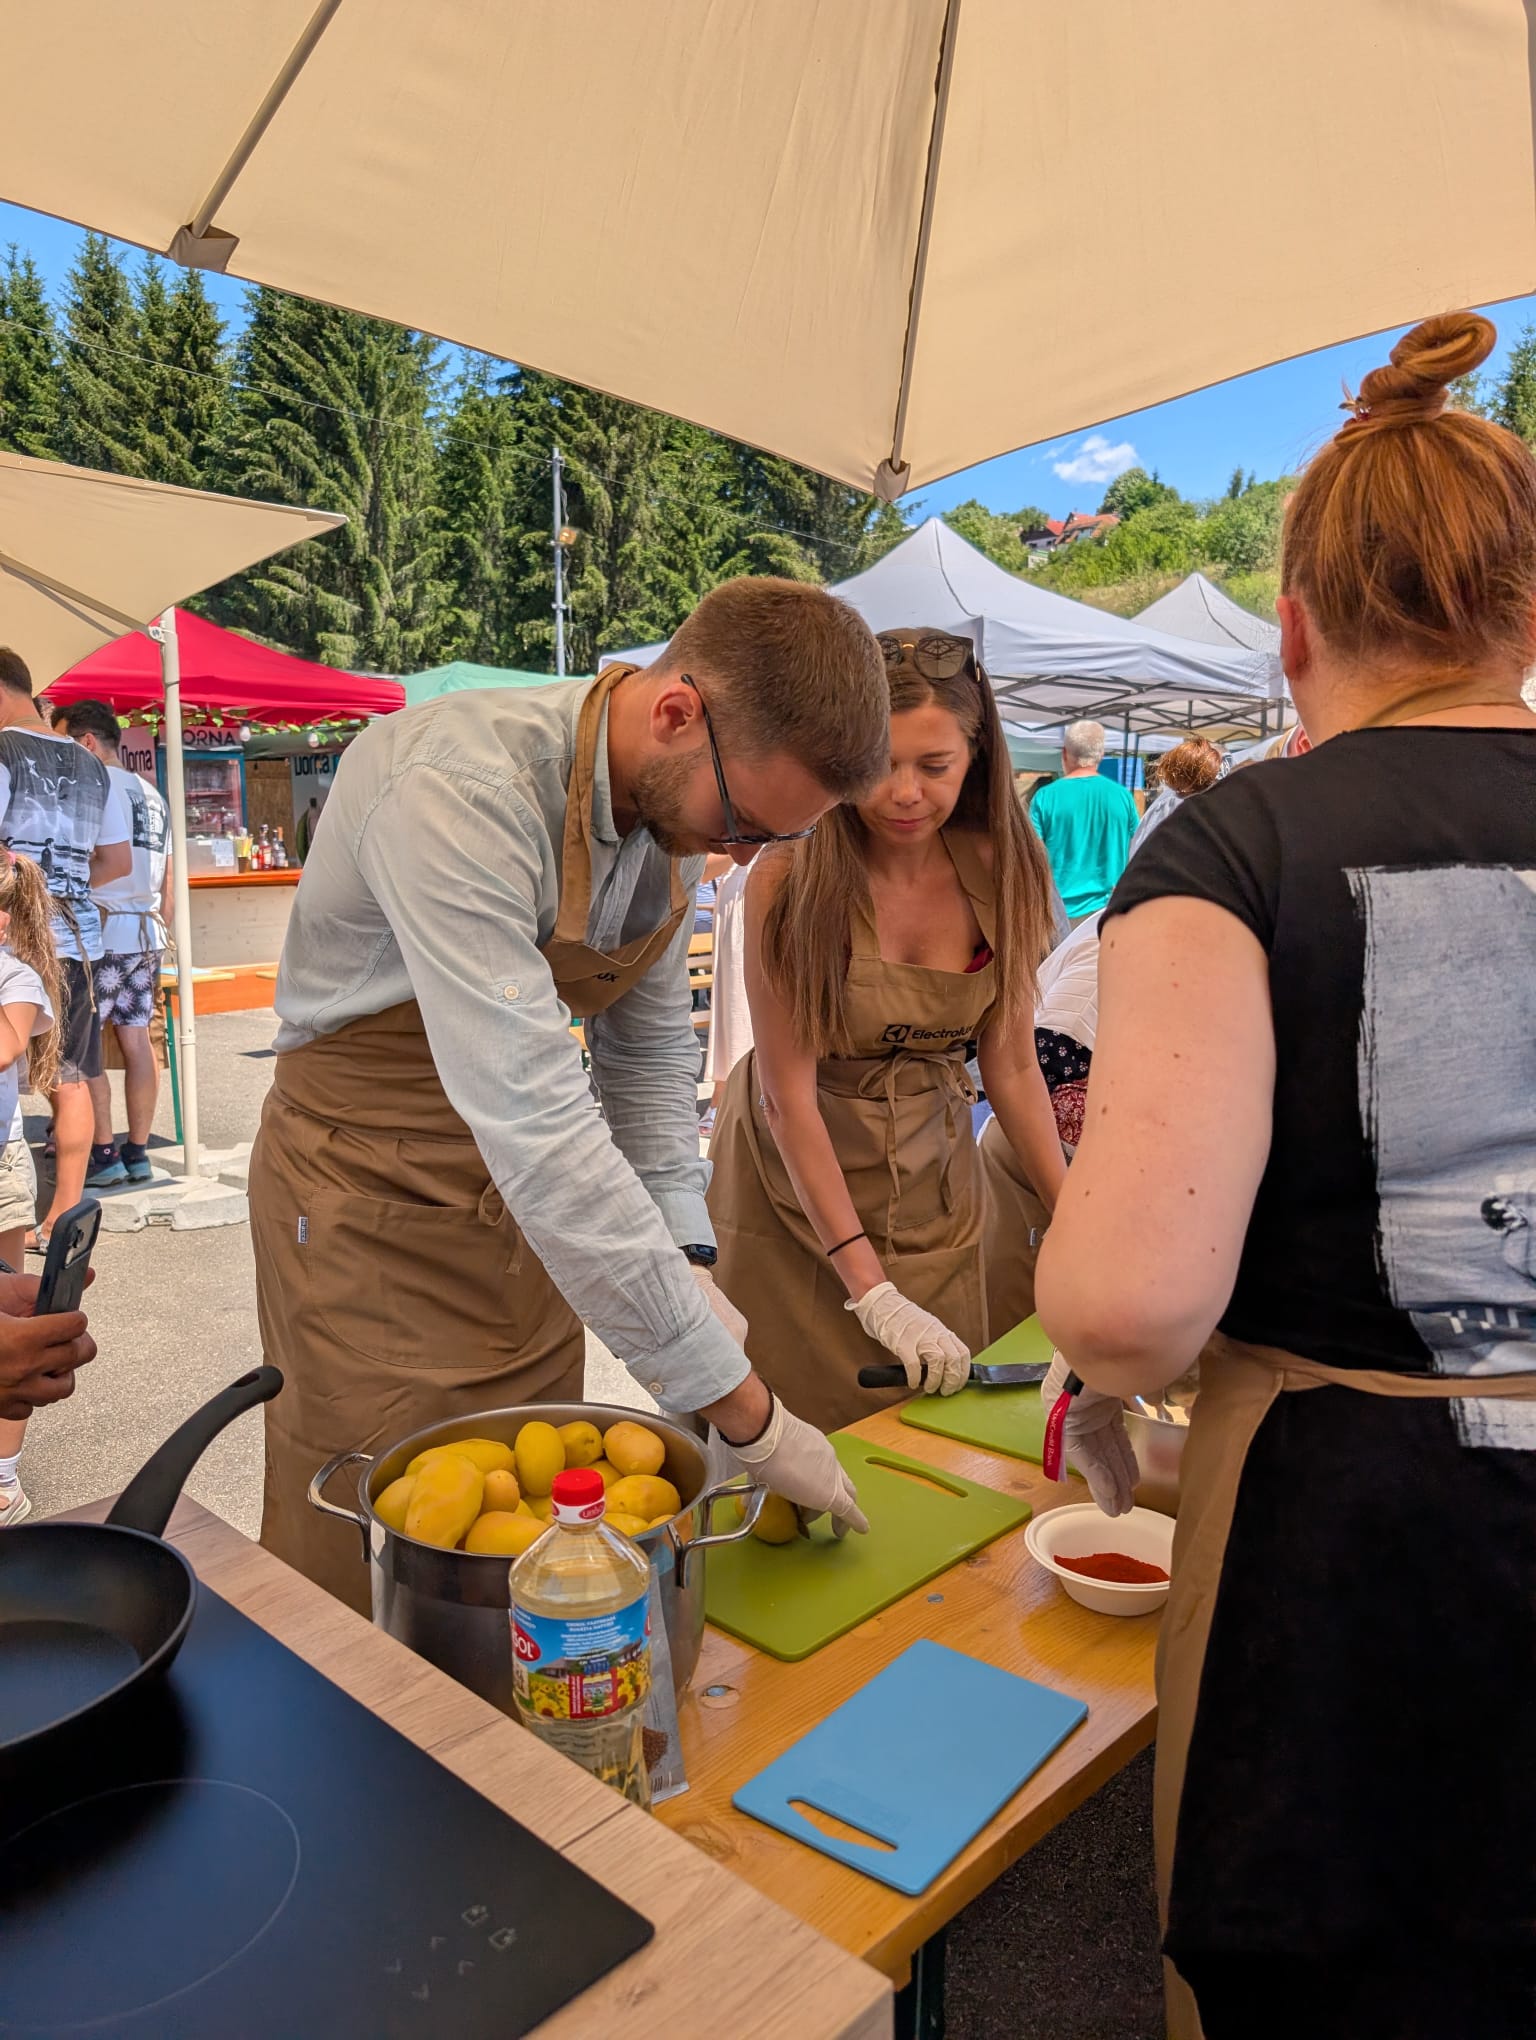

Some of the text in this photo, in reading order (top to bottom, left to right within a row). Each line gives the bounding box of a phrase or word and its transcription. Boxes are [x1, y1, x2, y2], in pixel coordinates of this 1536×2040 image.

[183, 728, 236, 747] ORNA
[121, 745, 153, 773] Dorna
[512, 1631, 535, 1660] SOL
